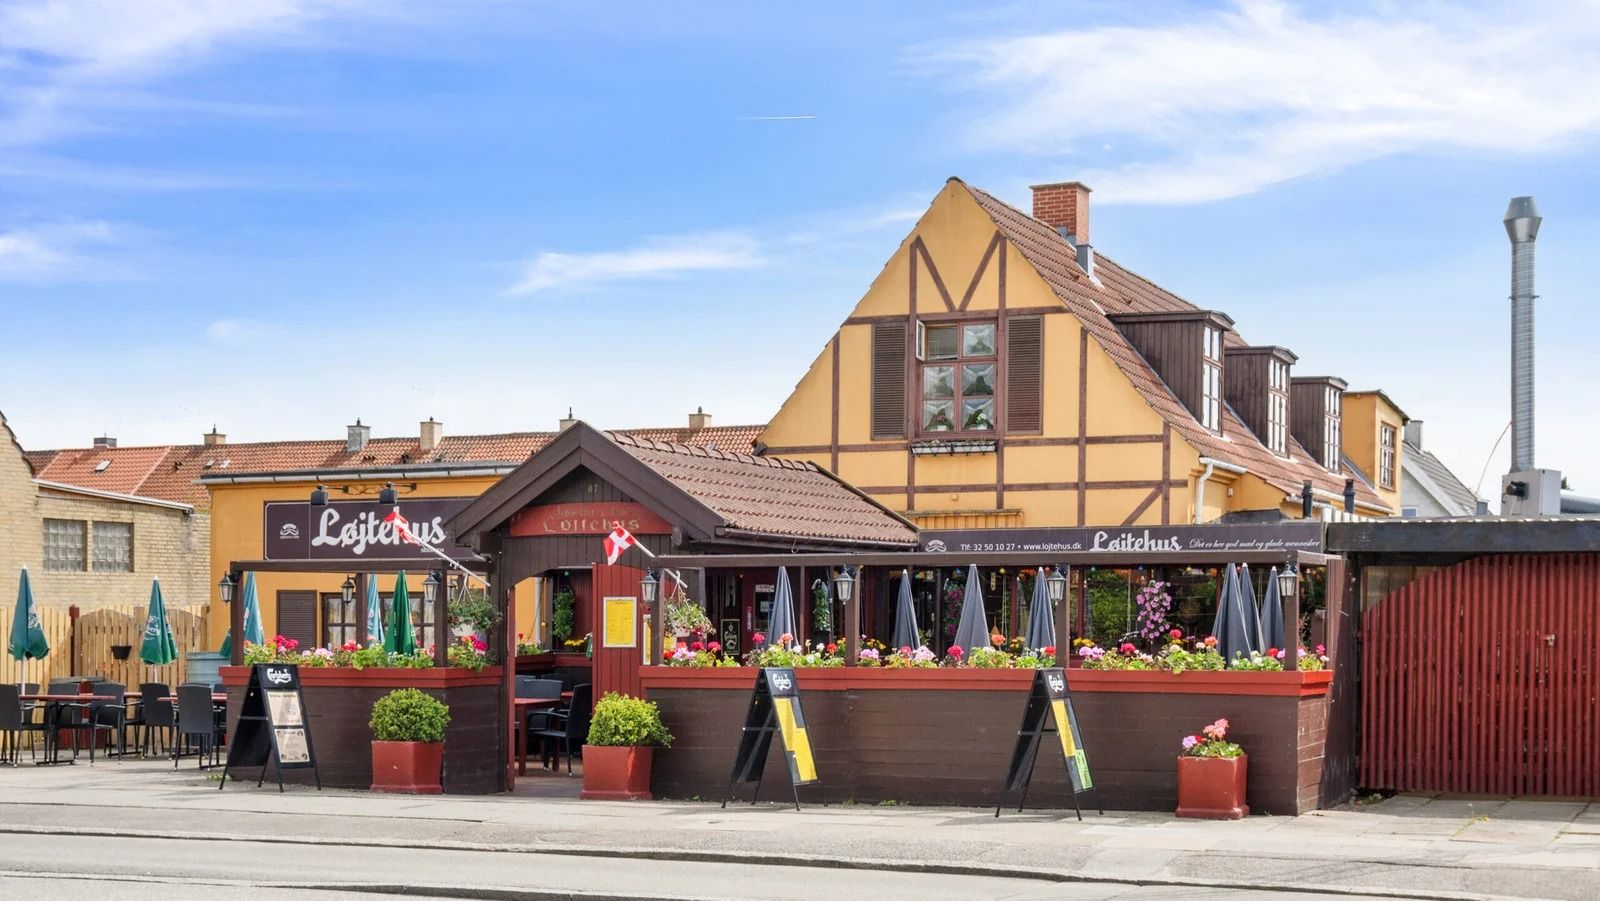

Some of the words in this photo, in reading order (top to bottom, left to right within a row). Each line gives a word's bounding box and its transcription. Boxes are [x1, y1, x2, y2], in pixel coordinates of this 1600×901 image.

[311, 505, 447, 555] Løjtehus
[960, 543, 972, 551] Tlf:
[973, 543, 983, 551] 32
[984, 543, 994, 551] 50
[995, 543, 1005, 551] 10
[1006, 543, 1016, 551] 27
